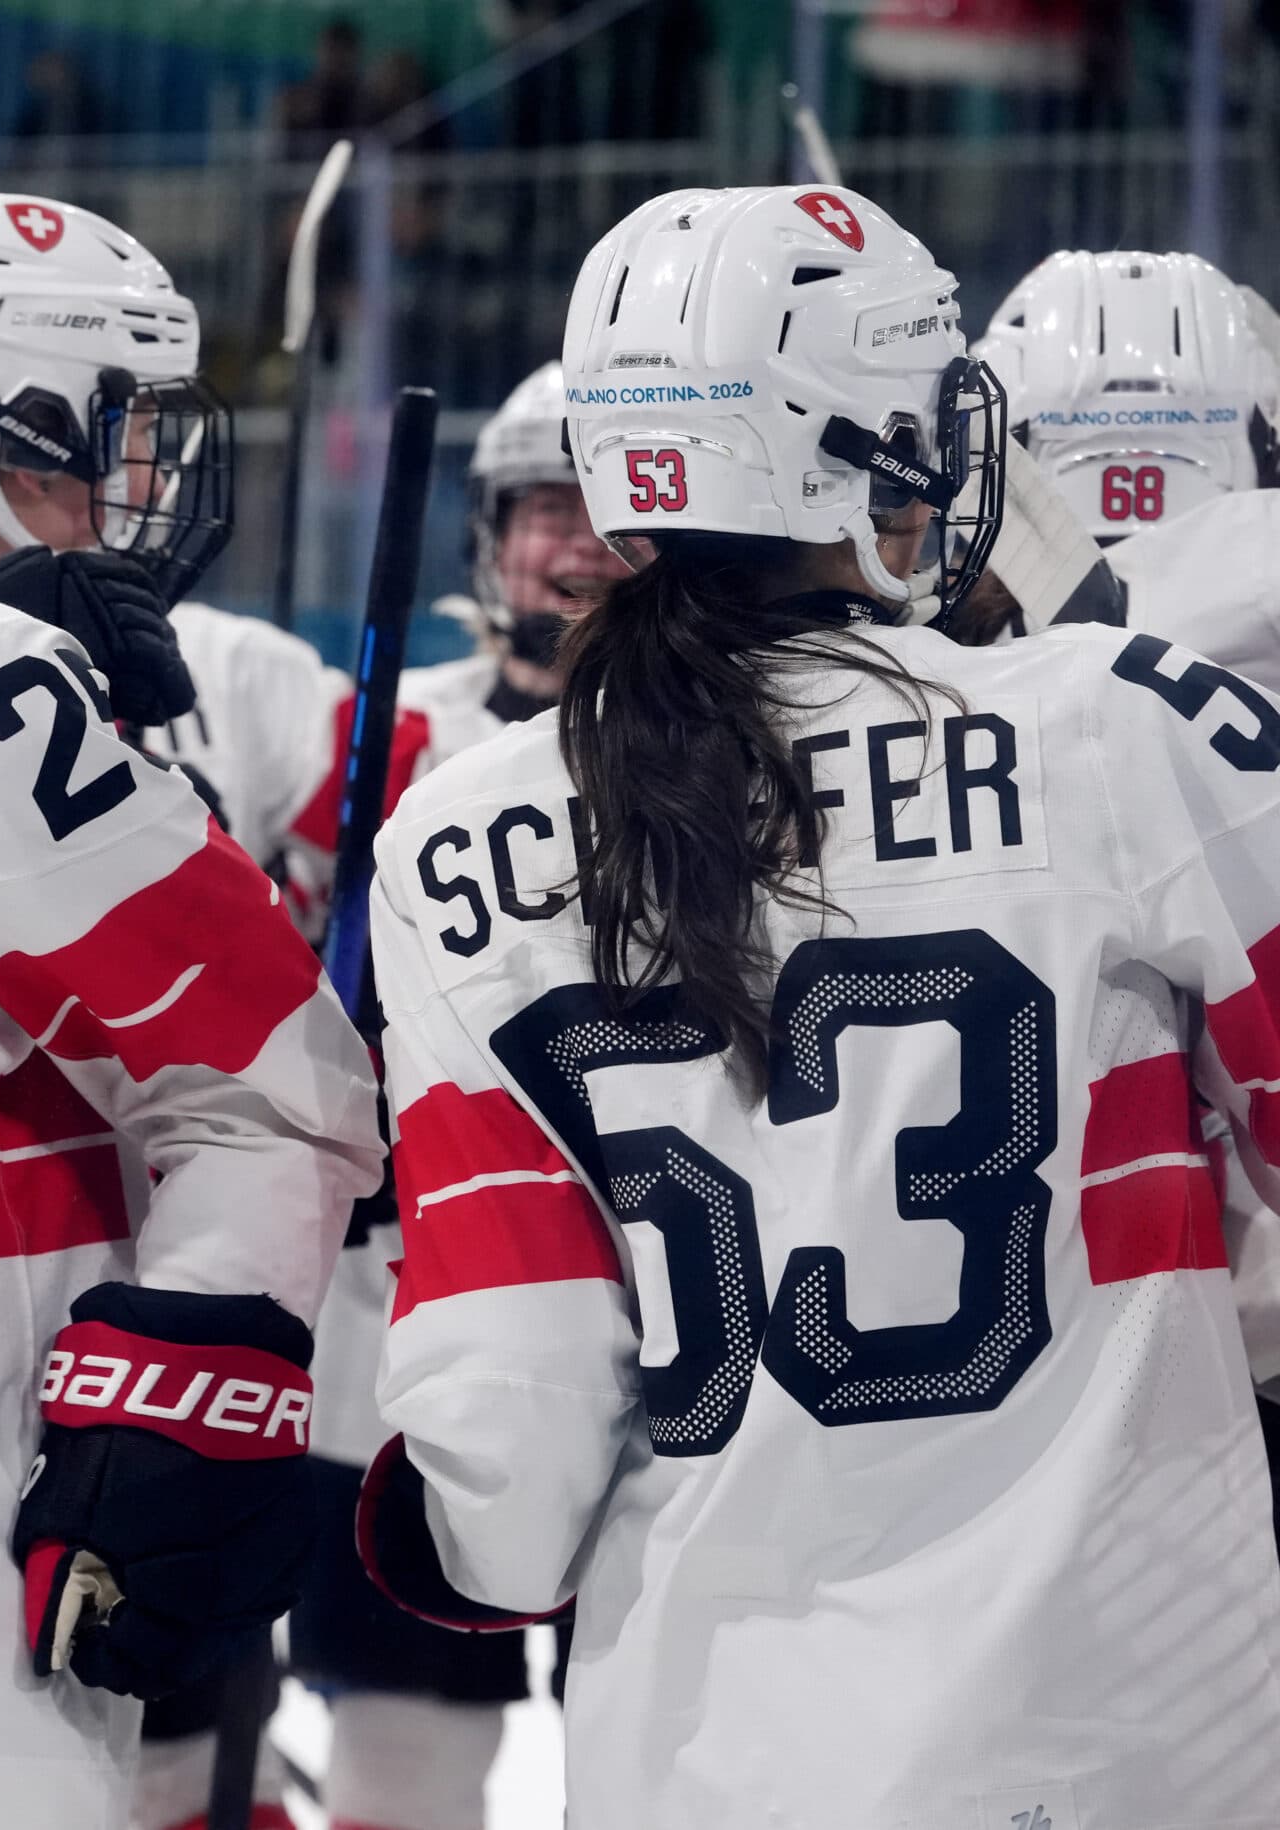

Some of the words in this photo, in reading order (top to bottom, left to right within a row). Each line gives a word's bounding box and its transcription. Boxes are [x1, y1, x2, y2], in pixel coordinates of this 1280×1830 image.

[565, 387, 617, 404] MILANO
[620, 386, 705, 404] CORTINA
[709, 381, 753, 400] 2026
[1032, 410, 1111, 426] MILANO
[1115, 410, 1198, 425] CORTINA
[625, 448, 688, 512] 53
[870, 452, 931, 491] BAUER
[1101, 465, 1165, 521] 68
[488, 927, 1058, 1458] 53
[38, 1350, 313, 1446] BAUER
